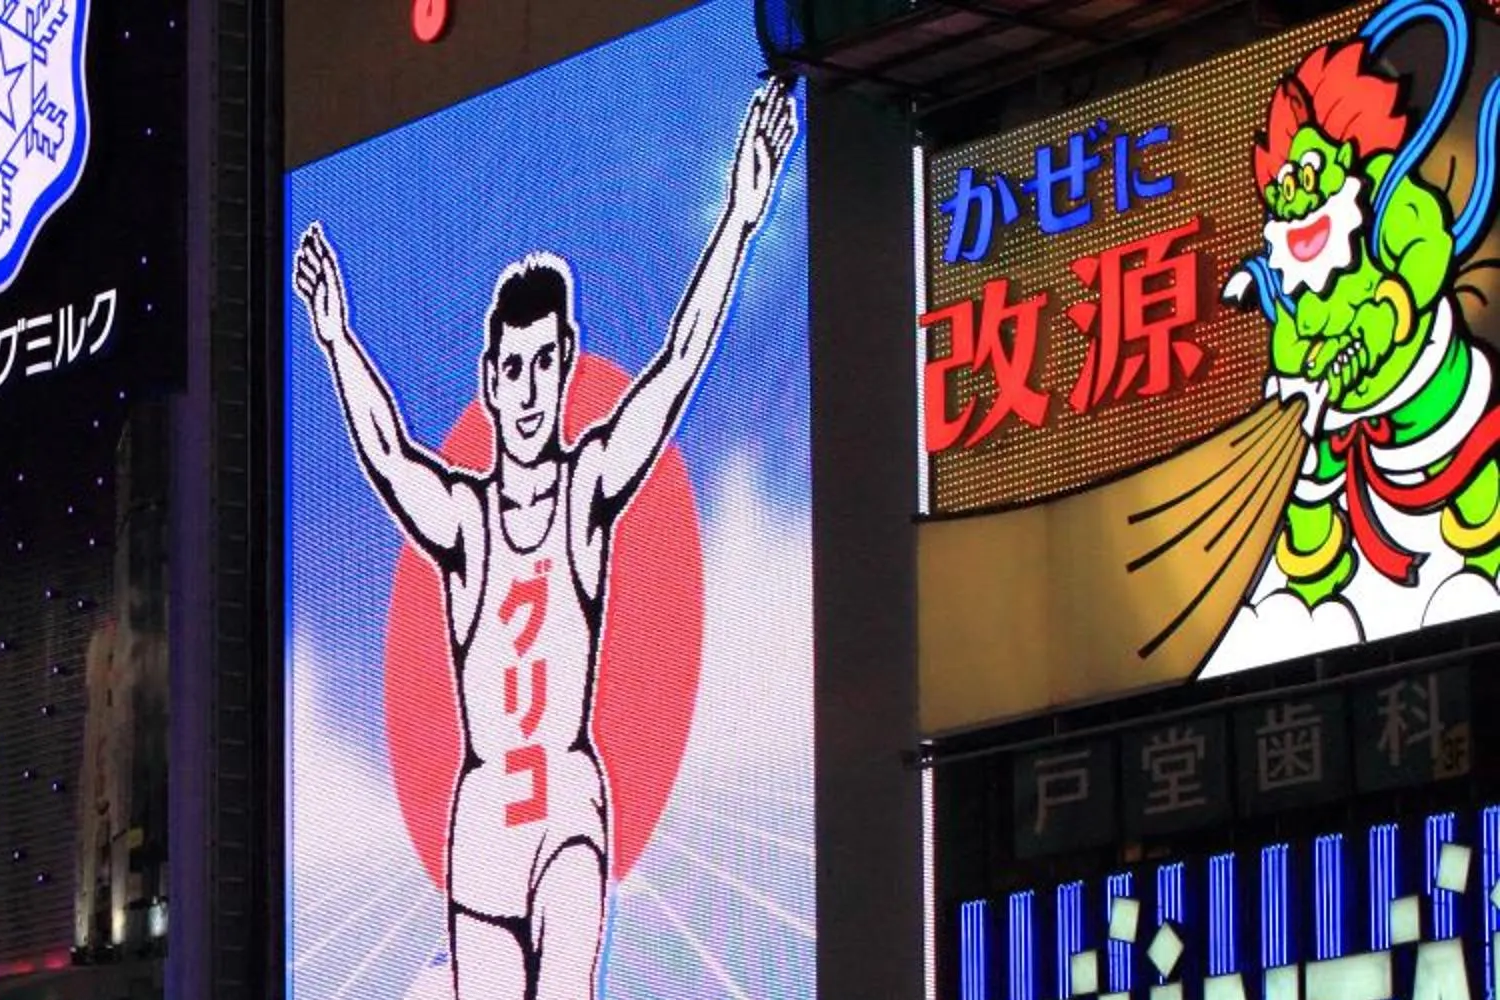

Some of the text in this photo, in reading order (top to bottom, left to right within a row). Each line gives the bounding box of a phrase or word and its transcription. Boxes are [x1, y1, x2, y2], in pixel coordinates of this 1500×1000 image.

[940, 117, 1175, 263] かぜに
[919, 217, 1203, 454] 改源
[498, 558, 553, 829] グリコ
[1032, 671, 1444, 837] 戸堂歯科
